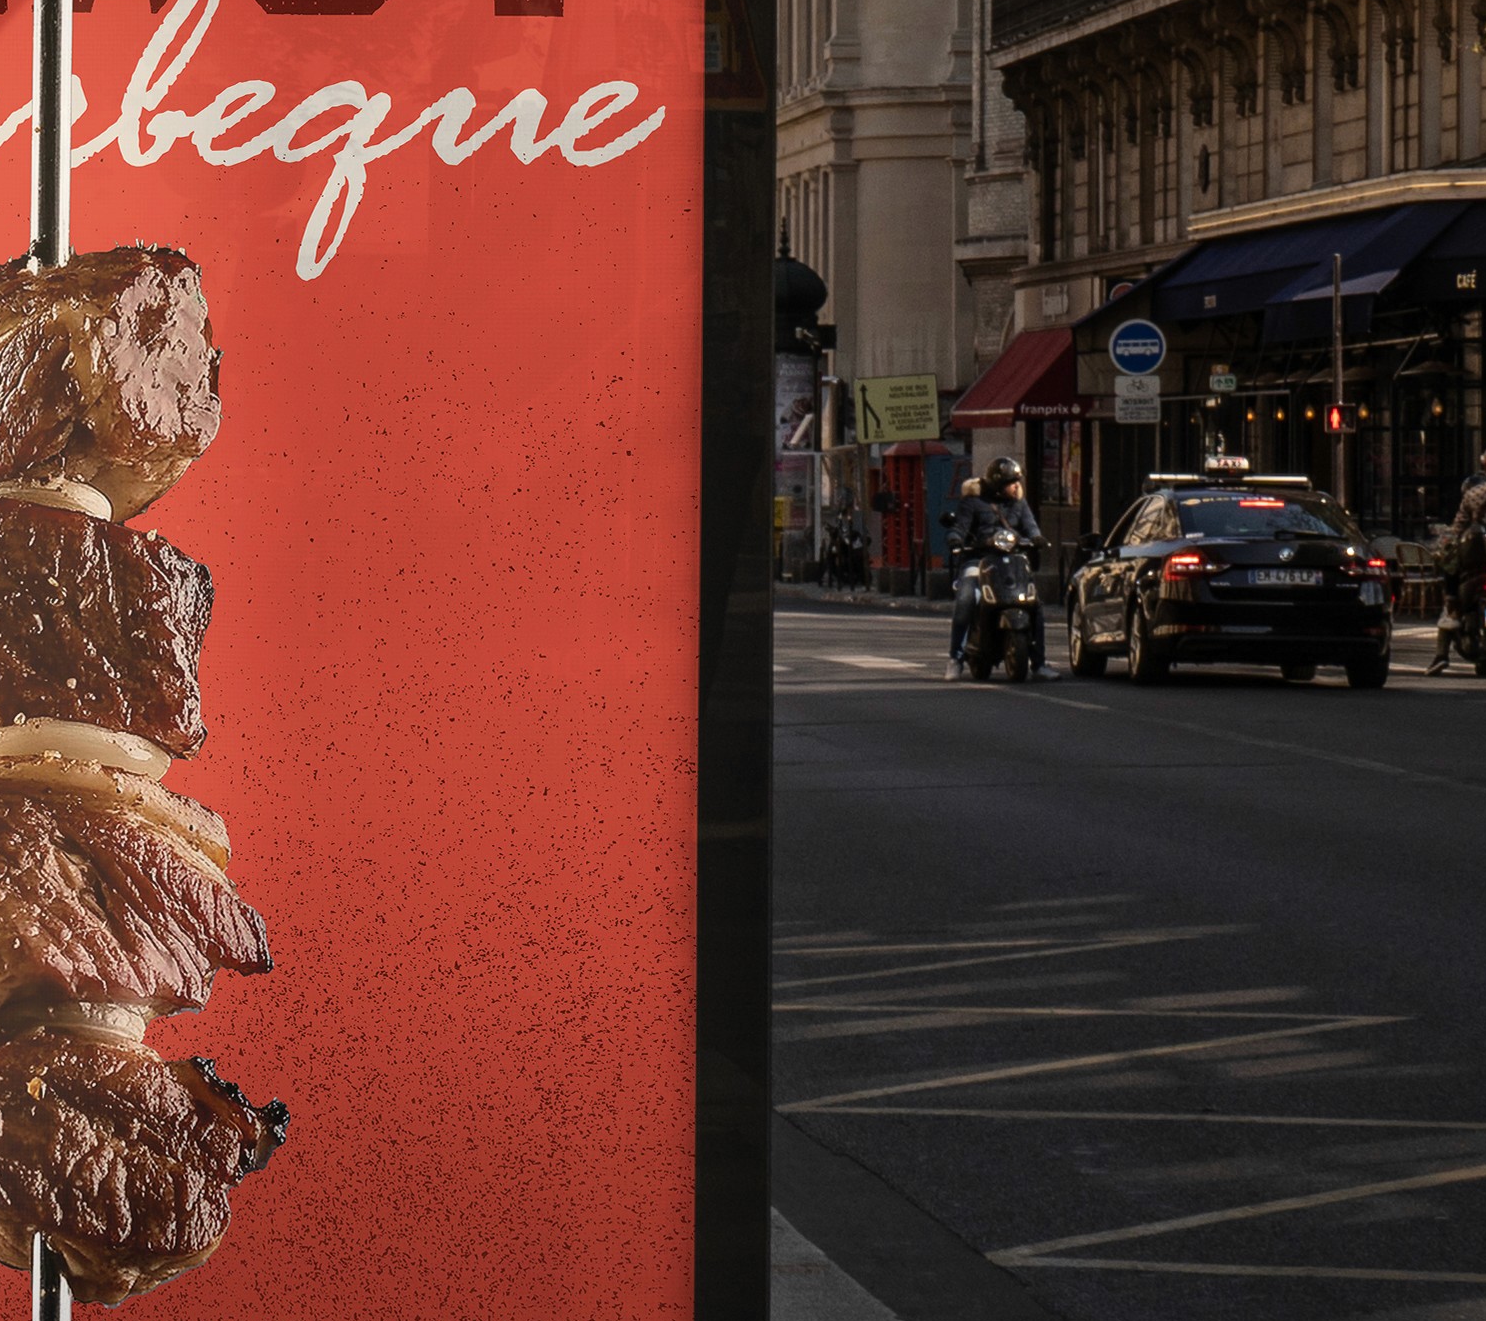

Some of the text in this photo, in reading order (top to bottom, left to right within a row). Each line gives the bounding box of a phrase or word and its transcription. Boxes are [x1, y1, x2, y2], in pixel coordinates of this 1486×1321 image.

[1457, 269, 1477, 288] CAFÉ
[1020, 403, 1069, 416] franprix
[1216, 459, 1242, 468] TAXI
